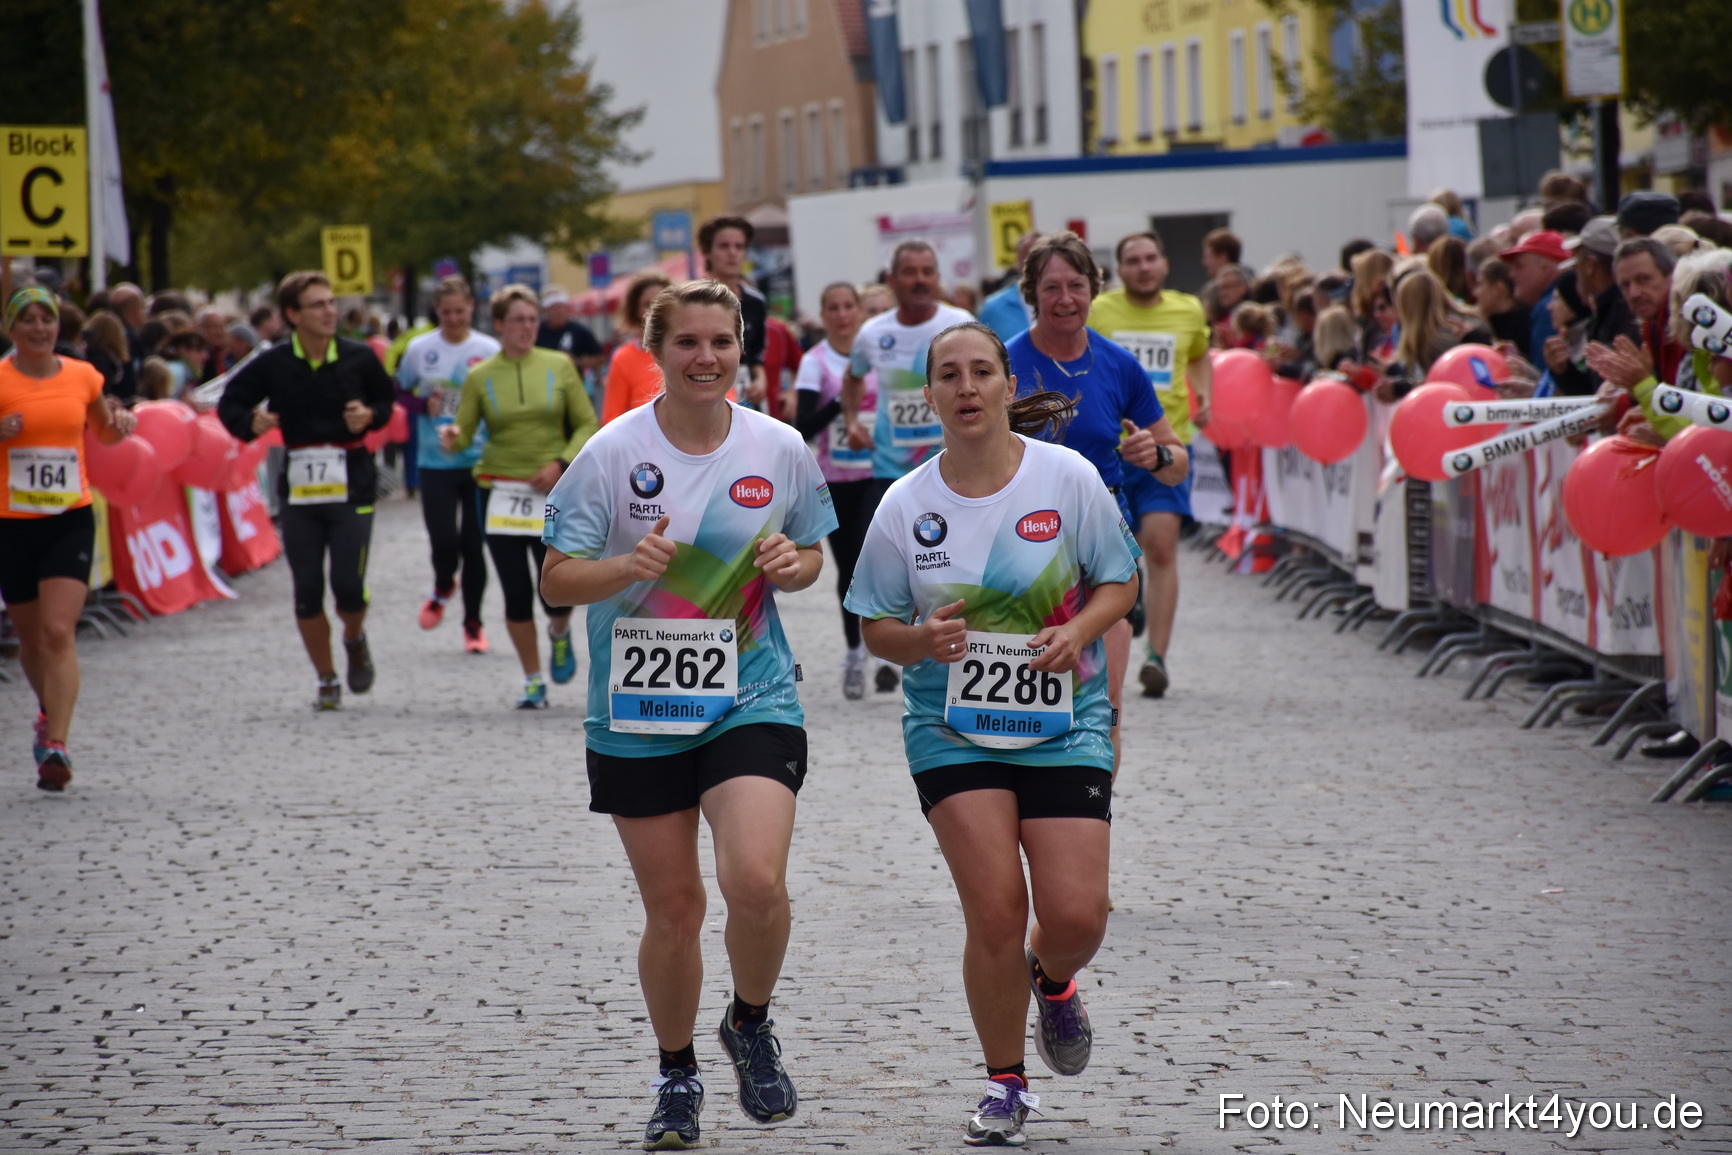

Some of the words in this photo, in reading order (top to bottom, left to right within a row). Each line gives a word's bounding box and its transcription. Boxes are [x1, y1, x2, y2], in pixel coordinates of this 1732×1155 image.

[8, 132, 76, 156] Block
[21, 165, 65, 228] C
[336, 248, 360, 281] D
[1481, 434, 1527, 464] BMW
[26, 463, 67, 489] 164
[305, 462, 328, 482] 17
[736, 484, 770, 500] Hervis
[509, 496, 533, 517] 76
[629, 502, 666, 514] PARTL
[915, 551, 950, 564] PARTL
[916, 560, 951, 571] Neumarkt
[614, 628, 653, 641] PARTL
[656, 630, 715, 642] Neumarkt
[622, 646, 726, 690] 2262
[960, 659, 1062, 706] 2286
[639, 699, 705, 718] Melanie
[975, 713, 1042, 734] Melanie
